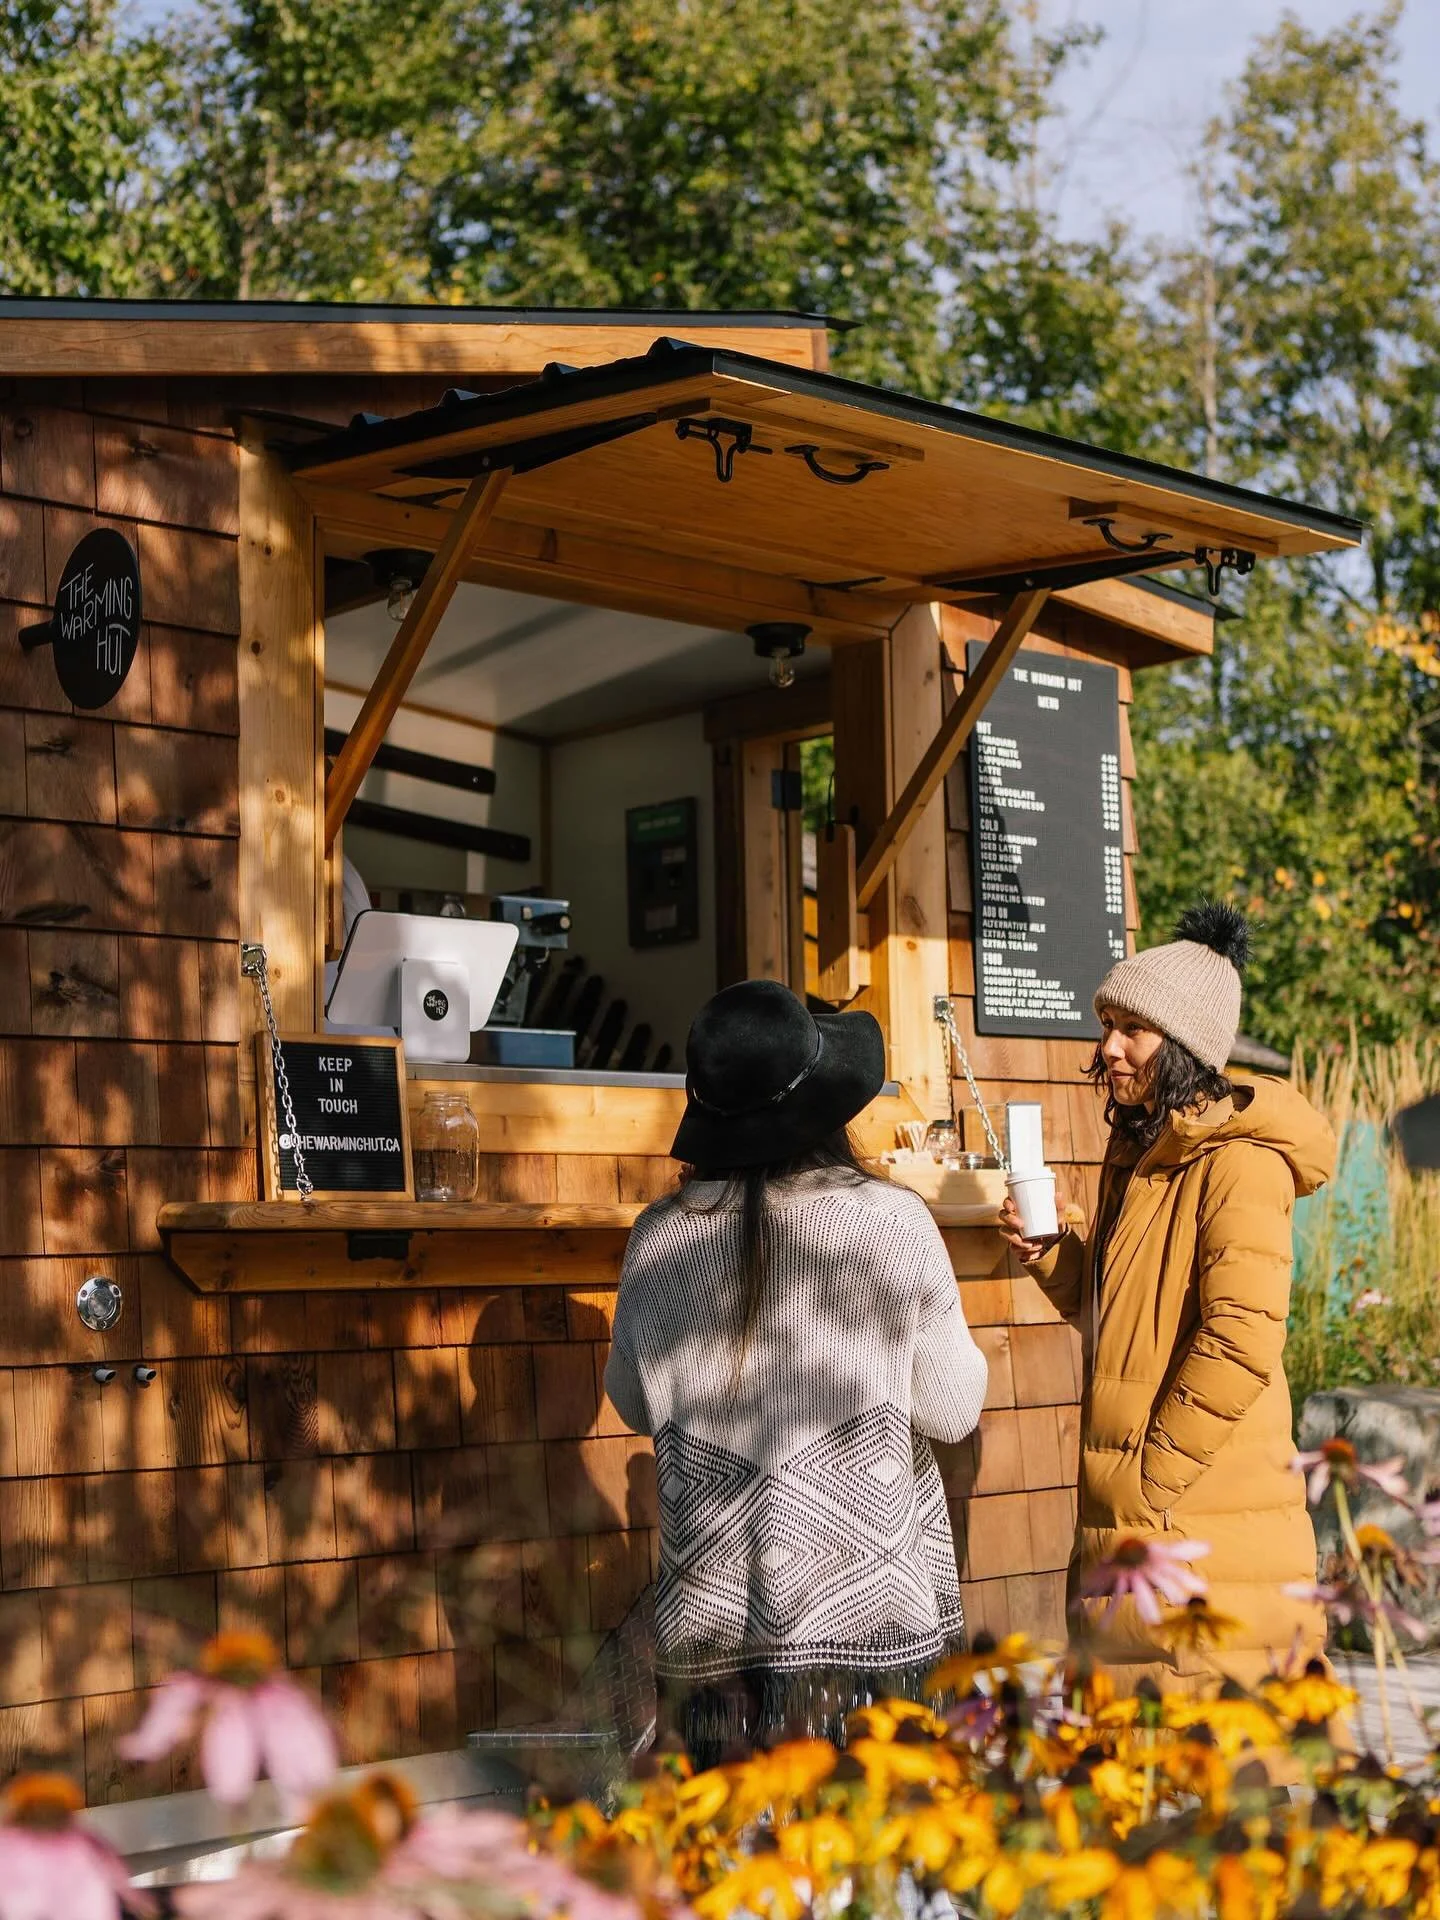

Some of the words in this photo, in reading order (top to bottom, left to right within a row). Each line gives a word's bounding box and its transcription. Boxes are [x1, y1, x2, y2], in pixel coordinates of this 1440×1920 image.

[61, 563, 94, 609] THE
[60, 576, 133, 640] WARMING
[96, 623, 131, 675] HUT
[1013, 668, 1028, 682] THE
[1030, 671, 1065, 689] WARMING
[1038, 695, 1059, 711] MENU
[977, 721, 991, 735] HOT
[979, 745, 996, 755] FLAT
[997, 747, 1019, 759] WHITE
[979, 765, 1001, 776] LATTE
[979, 775, 1002, 786] MOCHA
[979, 786, 993, 794] HOT
[994, 787, 1035, 801] CHOCOLATE
[980, 795, 1006, 807] DOUBLE
[1008, 798, 1045, 811] ESPRESSO
[981, 805, 994, 814] TEA
[980, 818, 999, 831] COLD
[980, 832, 997, 841] ICED
[981, 841, 997, 851] ICED
[998, 843, 1022, 855] LATTE
[981, 851, 997, 861] ICED
[998, 853, 1022, 865] MOCHA
[981, 861, 1018, 874] LEMONADE
[982, 872, 1002, 882] JUICE
[982, 882, 1019, 893] KOMBUCHA
[982, 892, 1021, 904] SPARKLING
[1022, 896, 1045, 907] WATER
[982, 906, 997, 918] ADD
[998, 907, 1008, 919] ON
[982, 919, 1028, 931] ALTERNATIVE
[1029, 923, 1046, 933] MILK
[983, 928, 1006, 939] EXTRA
[1008, 931, 1026, 941] SHOT
[982, 938, 1007, 950] EXTRA
[1008, 941, 1022, 951] TEA
[1023, 942, 1038, 952] BAG
[982, 952, 1003, 966] FOOD
[983, 966, 1012, 977] BANANA
[1013, 967, 1037, 978] BREAD
[983, 975, 1017, 987] COCONUT
[1017, 978, 1041, 989] LEMON
[1042, 980, 1061, 990] LOAF
[984, 986, 1017, 997] COCONUT
[1018, 988, 1028, 998] PB
[1029, 988, 1075, 1001] POWERBALLS
[984, 996, 1026, 1008] CHOCOLATE
[1027, 999, 1044, 1009] CHIP
[1045, 1000, 1071, 1010] COOKIE
[985, 1006, 1013, 1017] SALTED
[1014, 1008, 1056, 1019] CHOCOLATE
[1056, 1010, 1082, 1021] COOKIE
[318, 1056, 352, 1072] KEEP
[329, 1078, 344, 1093] IN
[318, 1098, 358, 1114] TOUCH
